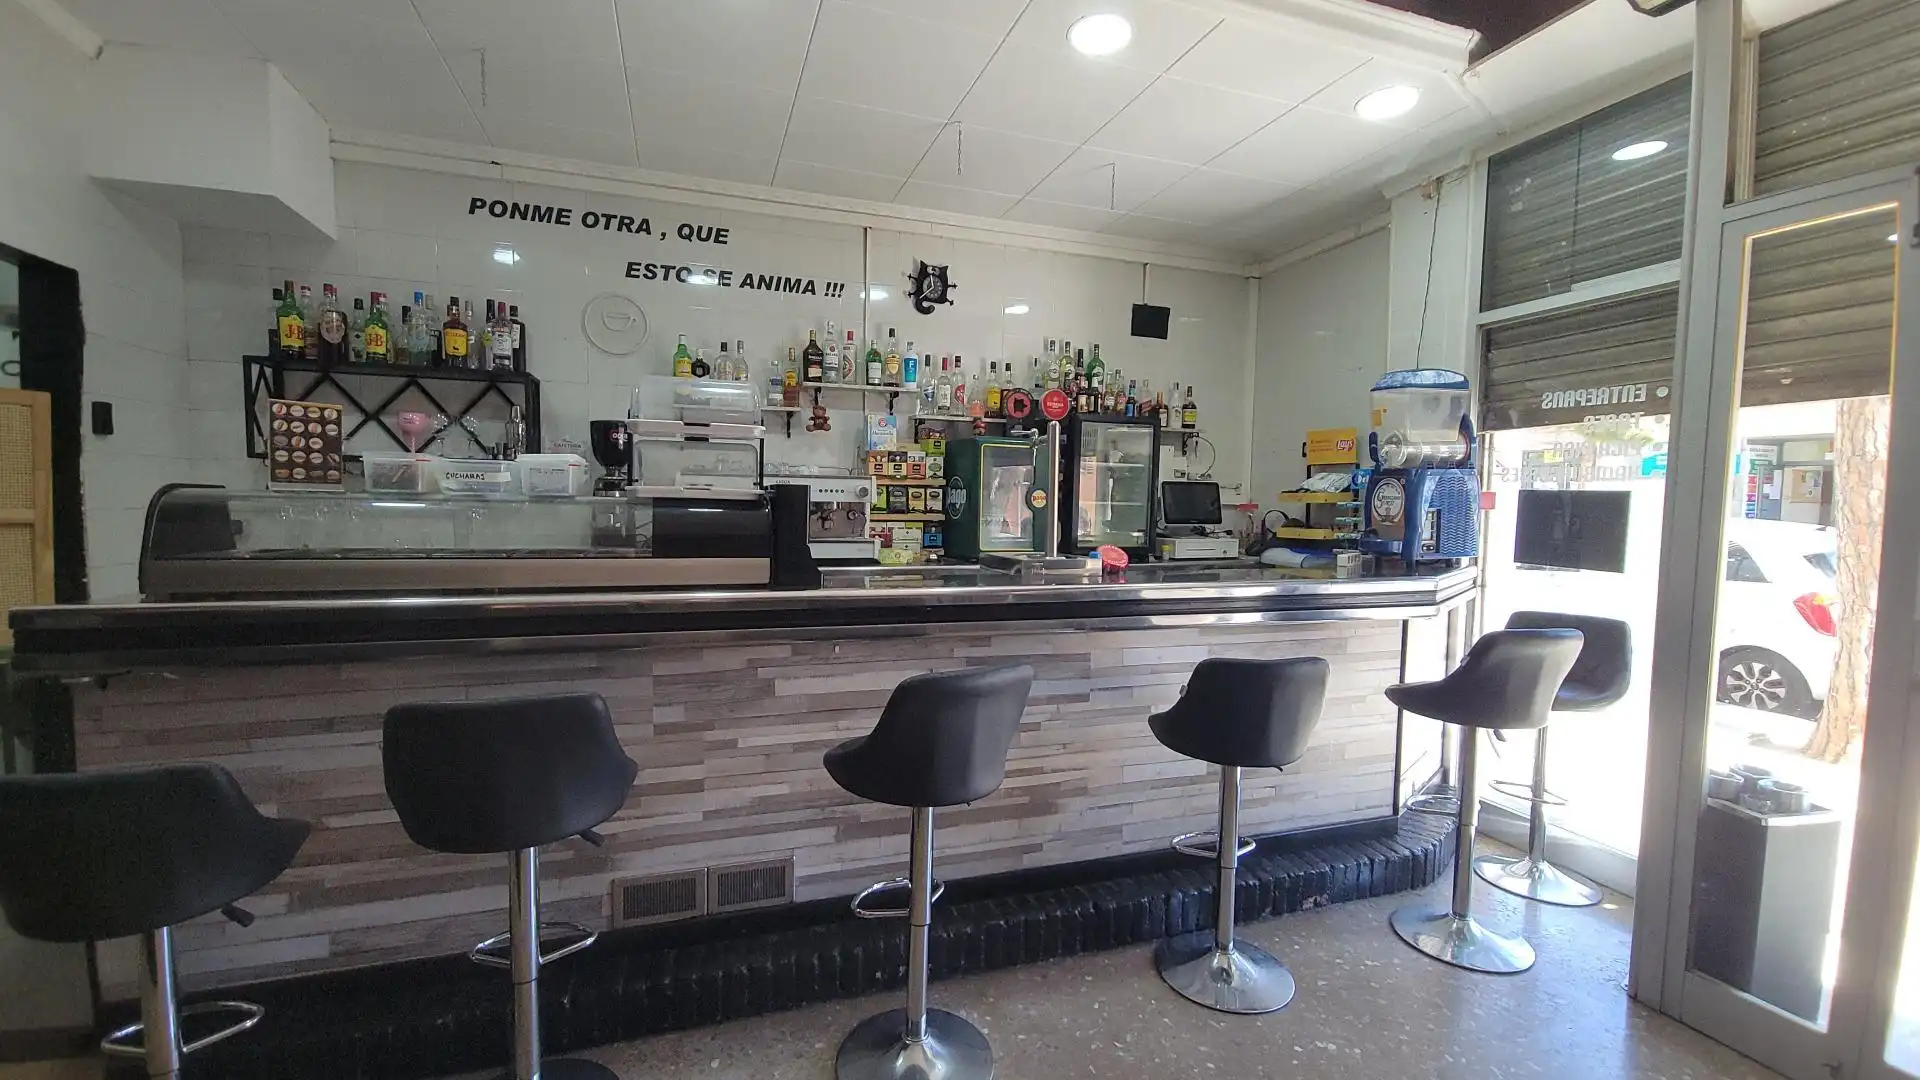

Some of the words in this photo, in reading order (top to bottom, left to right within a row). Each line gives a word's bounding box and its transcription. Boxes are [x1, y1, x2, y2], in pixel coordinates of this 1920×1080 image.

[468, 197, 572, 226] PONME
[581, 211, 652, 236] OTRA
[677, 223, 729, 245] QUE
[625, 261, 692, 283] ESTO
[739, 272, 817, 296] ANIMA
[824, 281, 845, 298] !!!
